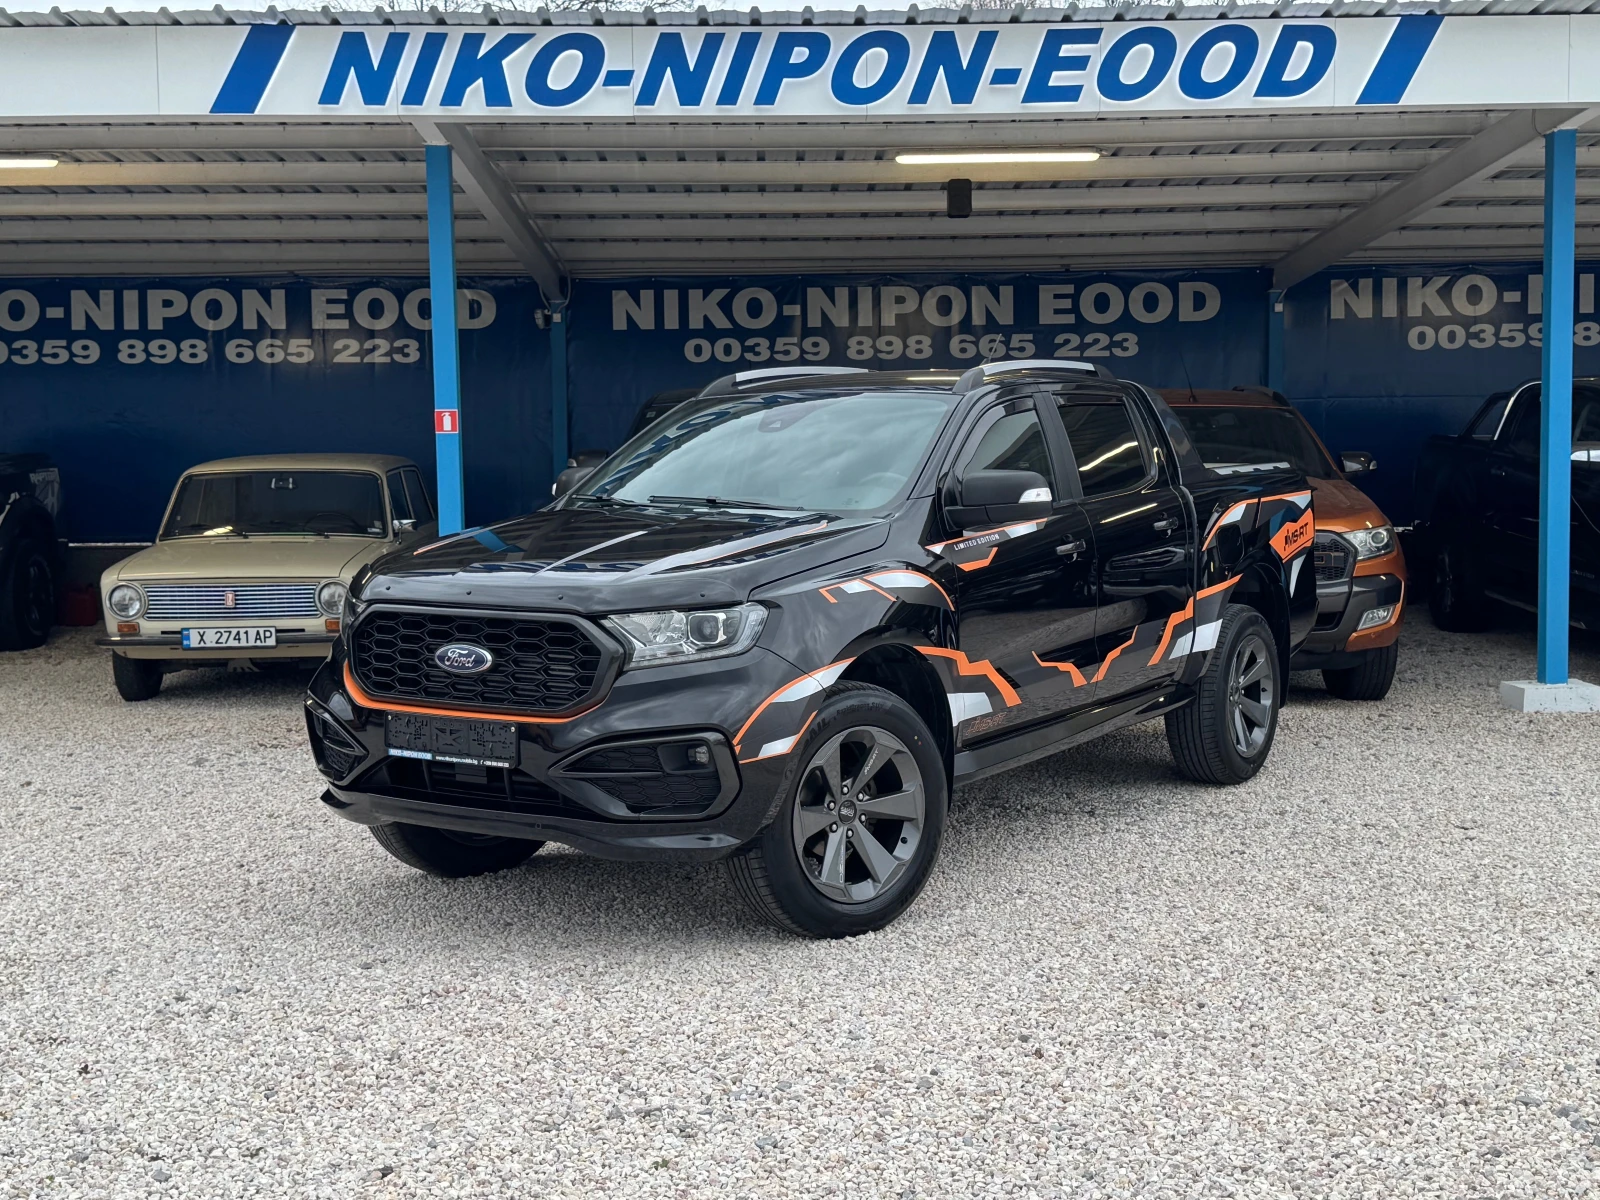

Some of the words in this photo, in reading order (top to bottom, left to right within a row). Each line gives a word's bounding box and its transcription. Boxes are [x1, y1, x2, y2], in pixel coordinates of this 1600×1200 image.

[317, 25, 1337, 107] NIKO-NIPON-EOOD
[611, 285, 1014, 331] NIKO-NIPON
[1039, 281, 1222, 325] EOOD
[117, 339, 209, 365] 898
[225, 338, 315, 364] 665
[332, 338, 421, 364] 223
[684, 335, 830, 363] 00359
[846, 334, 933, 361] 898
[949, 333, 1036, 360] 665
[1053, 332, 1139, 358] 223
[953, 540, 977, 551] LIMITED
[978, 533, 1000, 545] EDITION
[214, 629, 249, 645] 2741
[254, 629, 273, 644] AP
[444, 648, 476, 667] Ford
